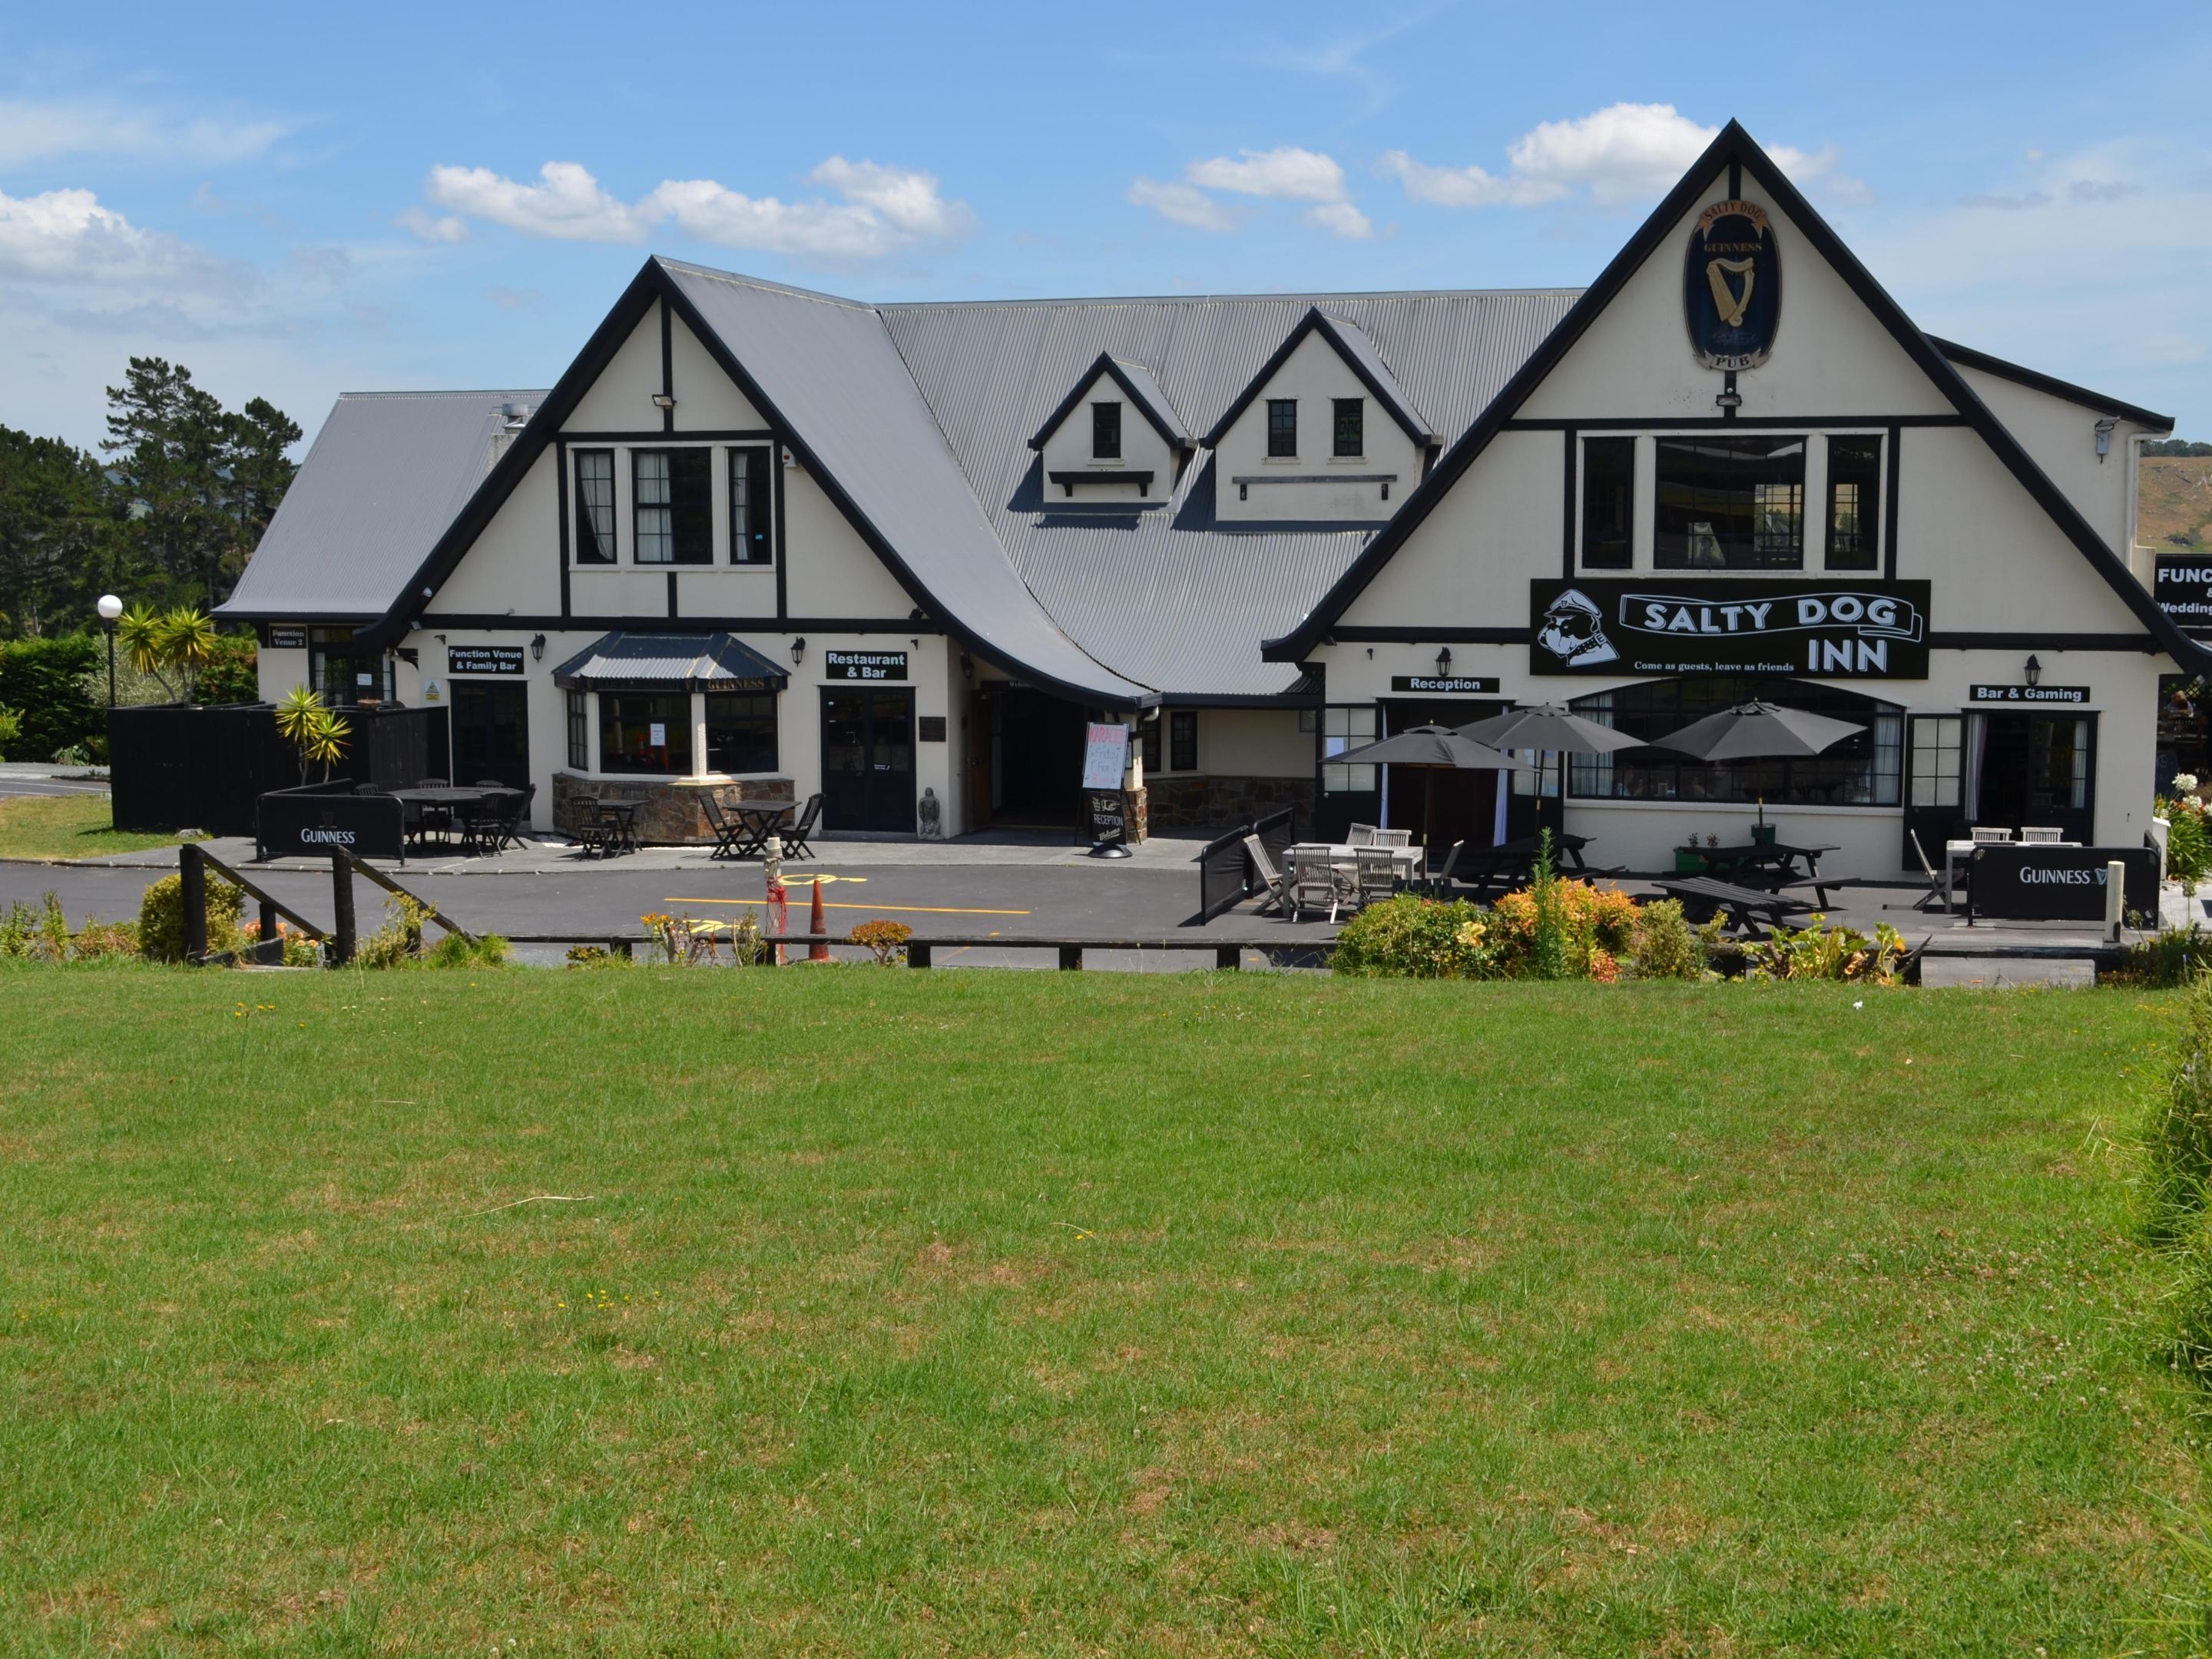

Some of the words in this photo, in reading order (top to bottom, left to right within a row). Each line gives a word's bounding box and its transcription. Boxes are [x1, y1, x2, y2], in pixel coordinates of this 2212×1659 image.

[1704, 202, 1737, 220] SALTY
[1740, 202, 1763, 220] DOG
[1704, 242, 1763, 253] GUINNESS
[1716, 356, 1750, 368] PUB
[1644, 602, 1773, 634] SALTY
[1796, 595, 1898, 627] DOG
[272, 629, 305, 637] Function
[449, 649, 491, 658] Function
[492, 650, 522, 659] Venue
[828, 652, 906, 666] Restaurant
[1808, 639, 1888, 673] INN
[455, 661, 464, 670] &
[465, 661, 498, 672] Family
[499, 661, 517, 671] Bar
[846, 666, 858, 678] &
[862, 667, 887, 678] Bar
[1634, 661, 1663, 671] Come
[1678, 663, 1713, 672] guests,
[1715, 661, 1742, 671] leave
[1757, 662, 1795, 671] friends
[707, 679, 765, 690] GUINNESS
[1410, 677, 1481, 691] Reception
[1977, 687, 2004, 699] Bar
[2008, 687, 2019, 699] &
[2025, 687, 2082, 702] Gaming
[1093, 813, 1124, 827] RECEPTION
[300, 828, 356, 844] GUINNESS
[2019, 866, 2091, 885] GUINNESS
